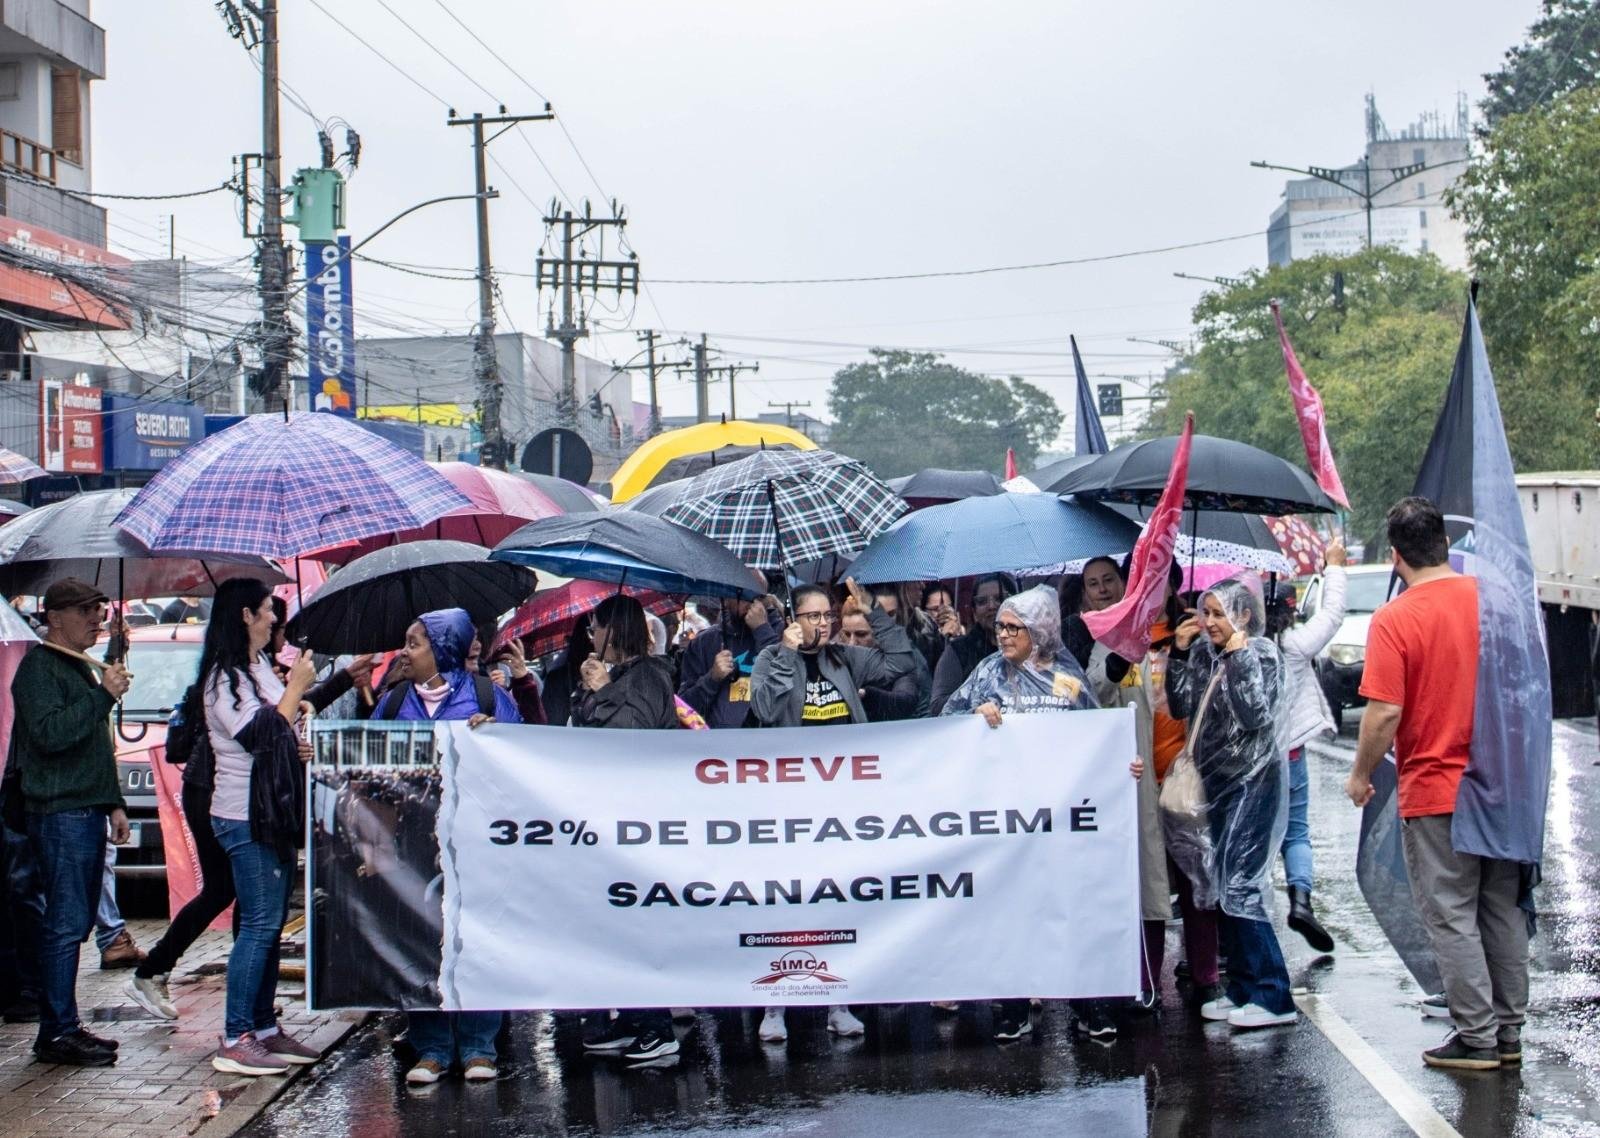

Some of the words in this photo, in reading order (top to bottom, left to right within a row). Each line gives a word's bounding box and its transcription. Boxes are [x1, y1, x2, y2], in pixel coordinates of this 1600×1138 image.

[316, 245, 344, 376] Colombo
[136, 412, 168, 437] SEVERO
[168, 415, 190, 438] ROTH
[695, 755, 881, 784] GREVE
[489, 819, 598, 846] 32%
[616, 820, 688, 845] DE
[706, 808, 1052, 844] DEFASAGEM
[1070, 798, 1098, 832] É
[607, 872, 974, 907] SACANAGEM
[745, 932, 853, 946] @simcacachoeirinha
[770, 959, 828, 972] SIMCA
[751, 984, 786, 992] Sindicato
[770, 990, 780, 998] de
[782, 990, 830, 998] Cachoeirinha
